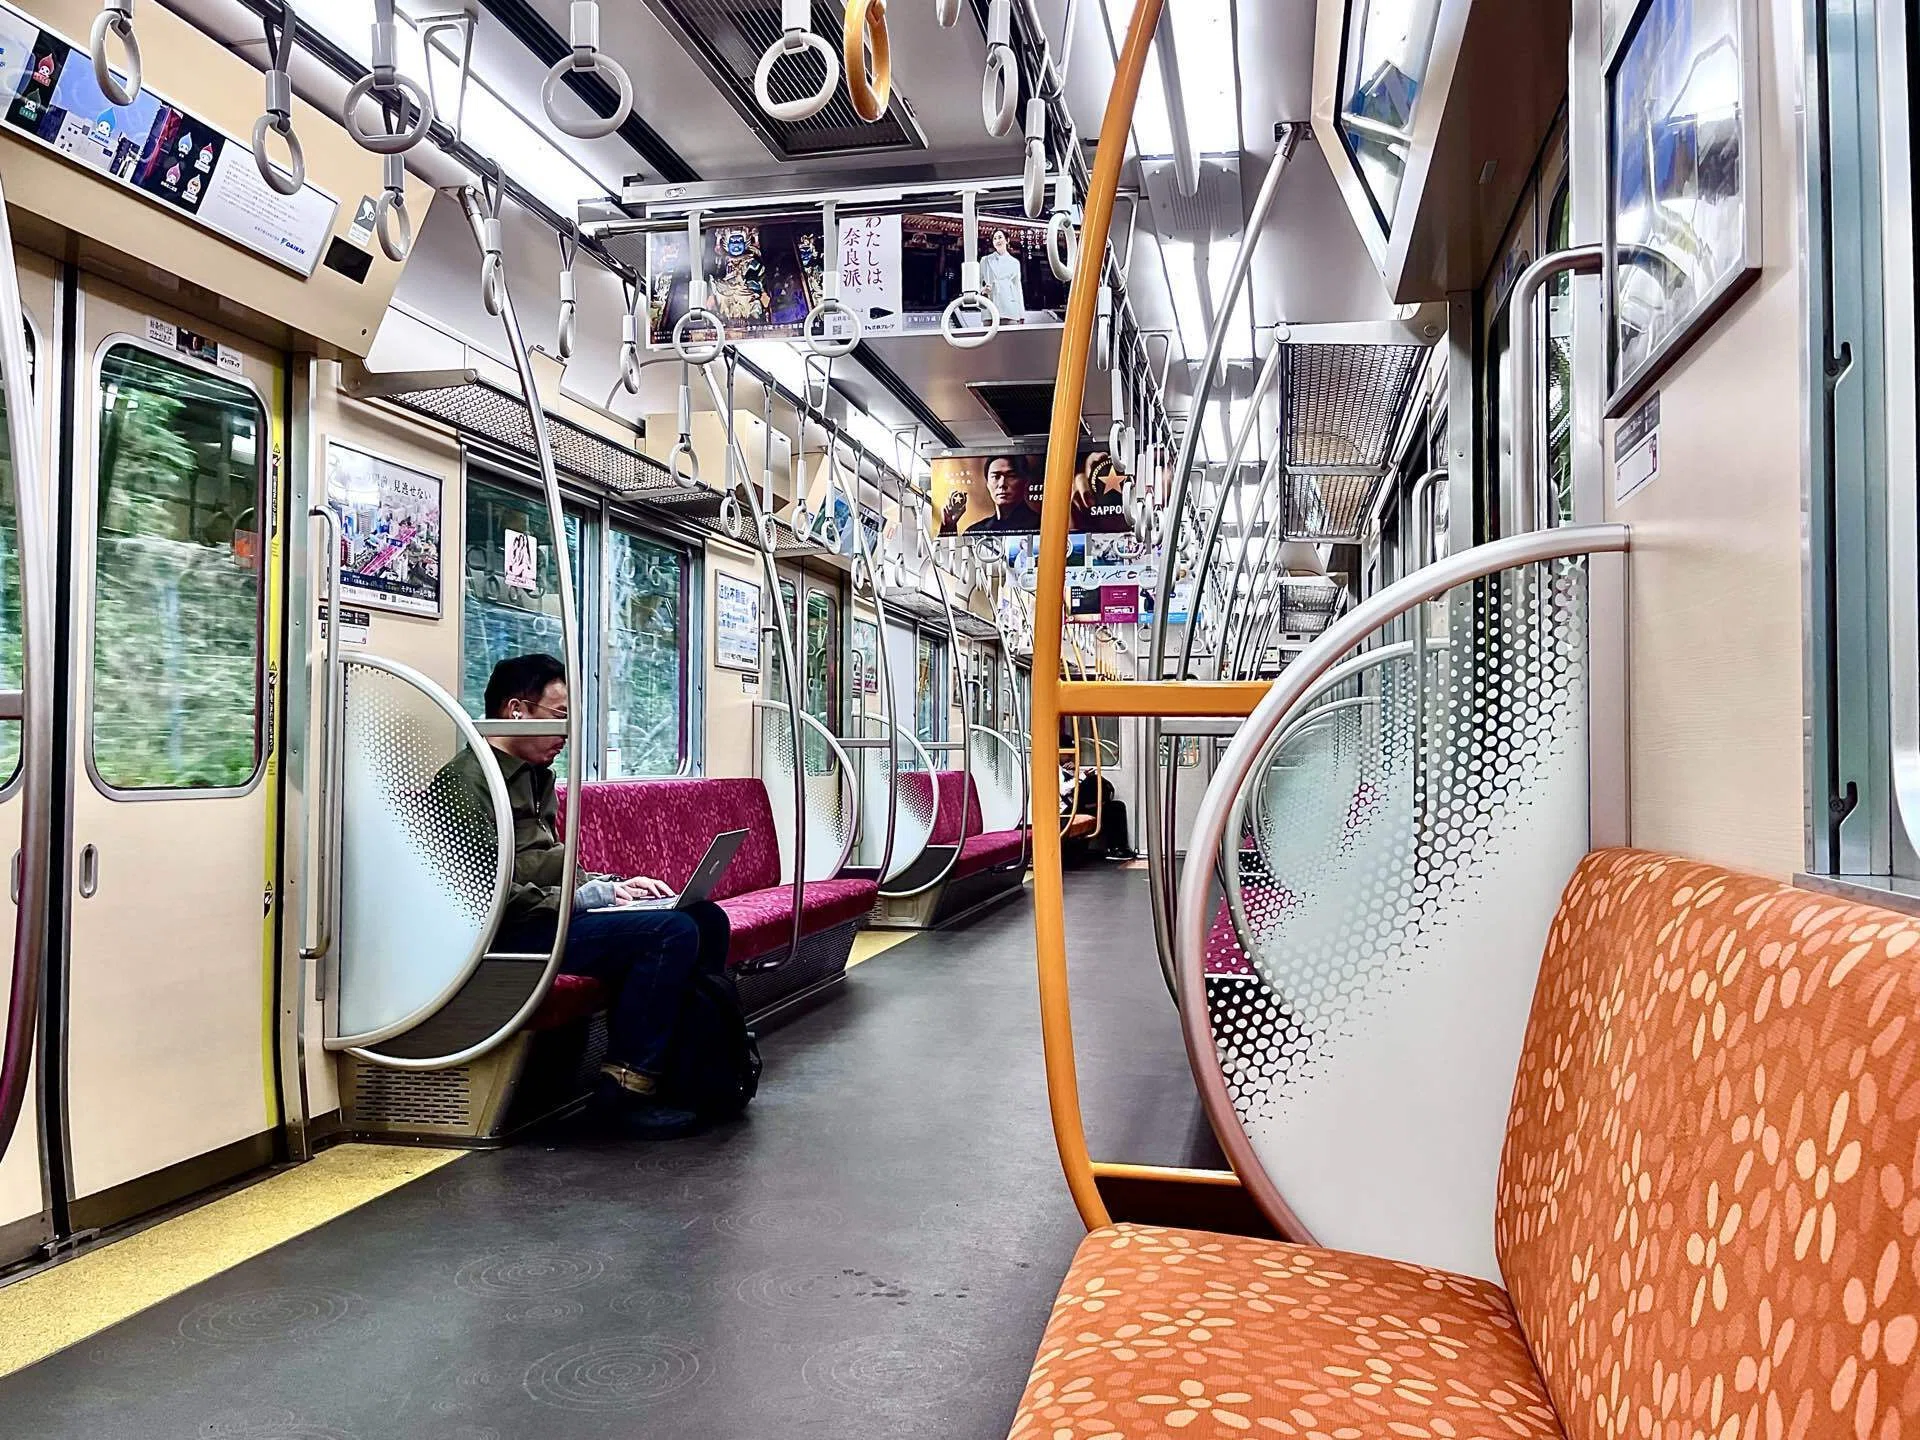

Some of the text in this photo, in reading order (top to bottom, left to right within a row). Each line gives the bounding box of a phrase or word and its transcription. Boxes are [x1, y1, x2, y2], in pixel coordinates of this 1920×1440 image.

[285, 241, 306, 255] DAIKIN
[865, 216, 884, 292] わたしは、
[843, 227, 862, 294] 奈良派。
[393, 479, 432, 500] 見逃せない
[1028, 484, 1044, 492] GET
[1090, 505, 1125, 516] SAPPO
